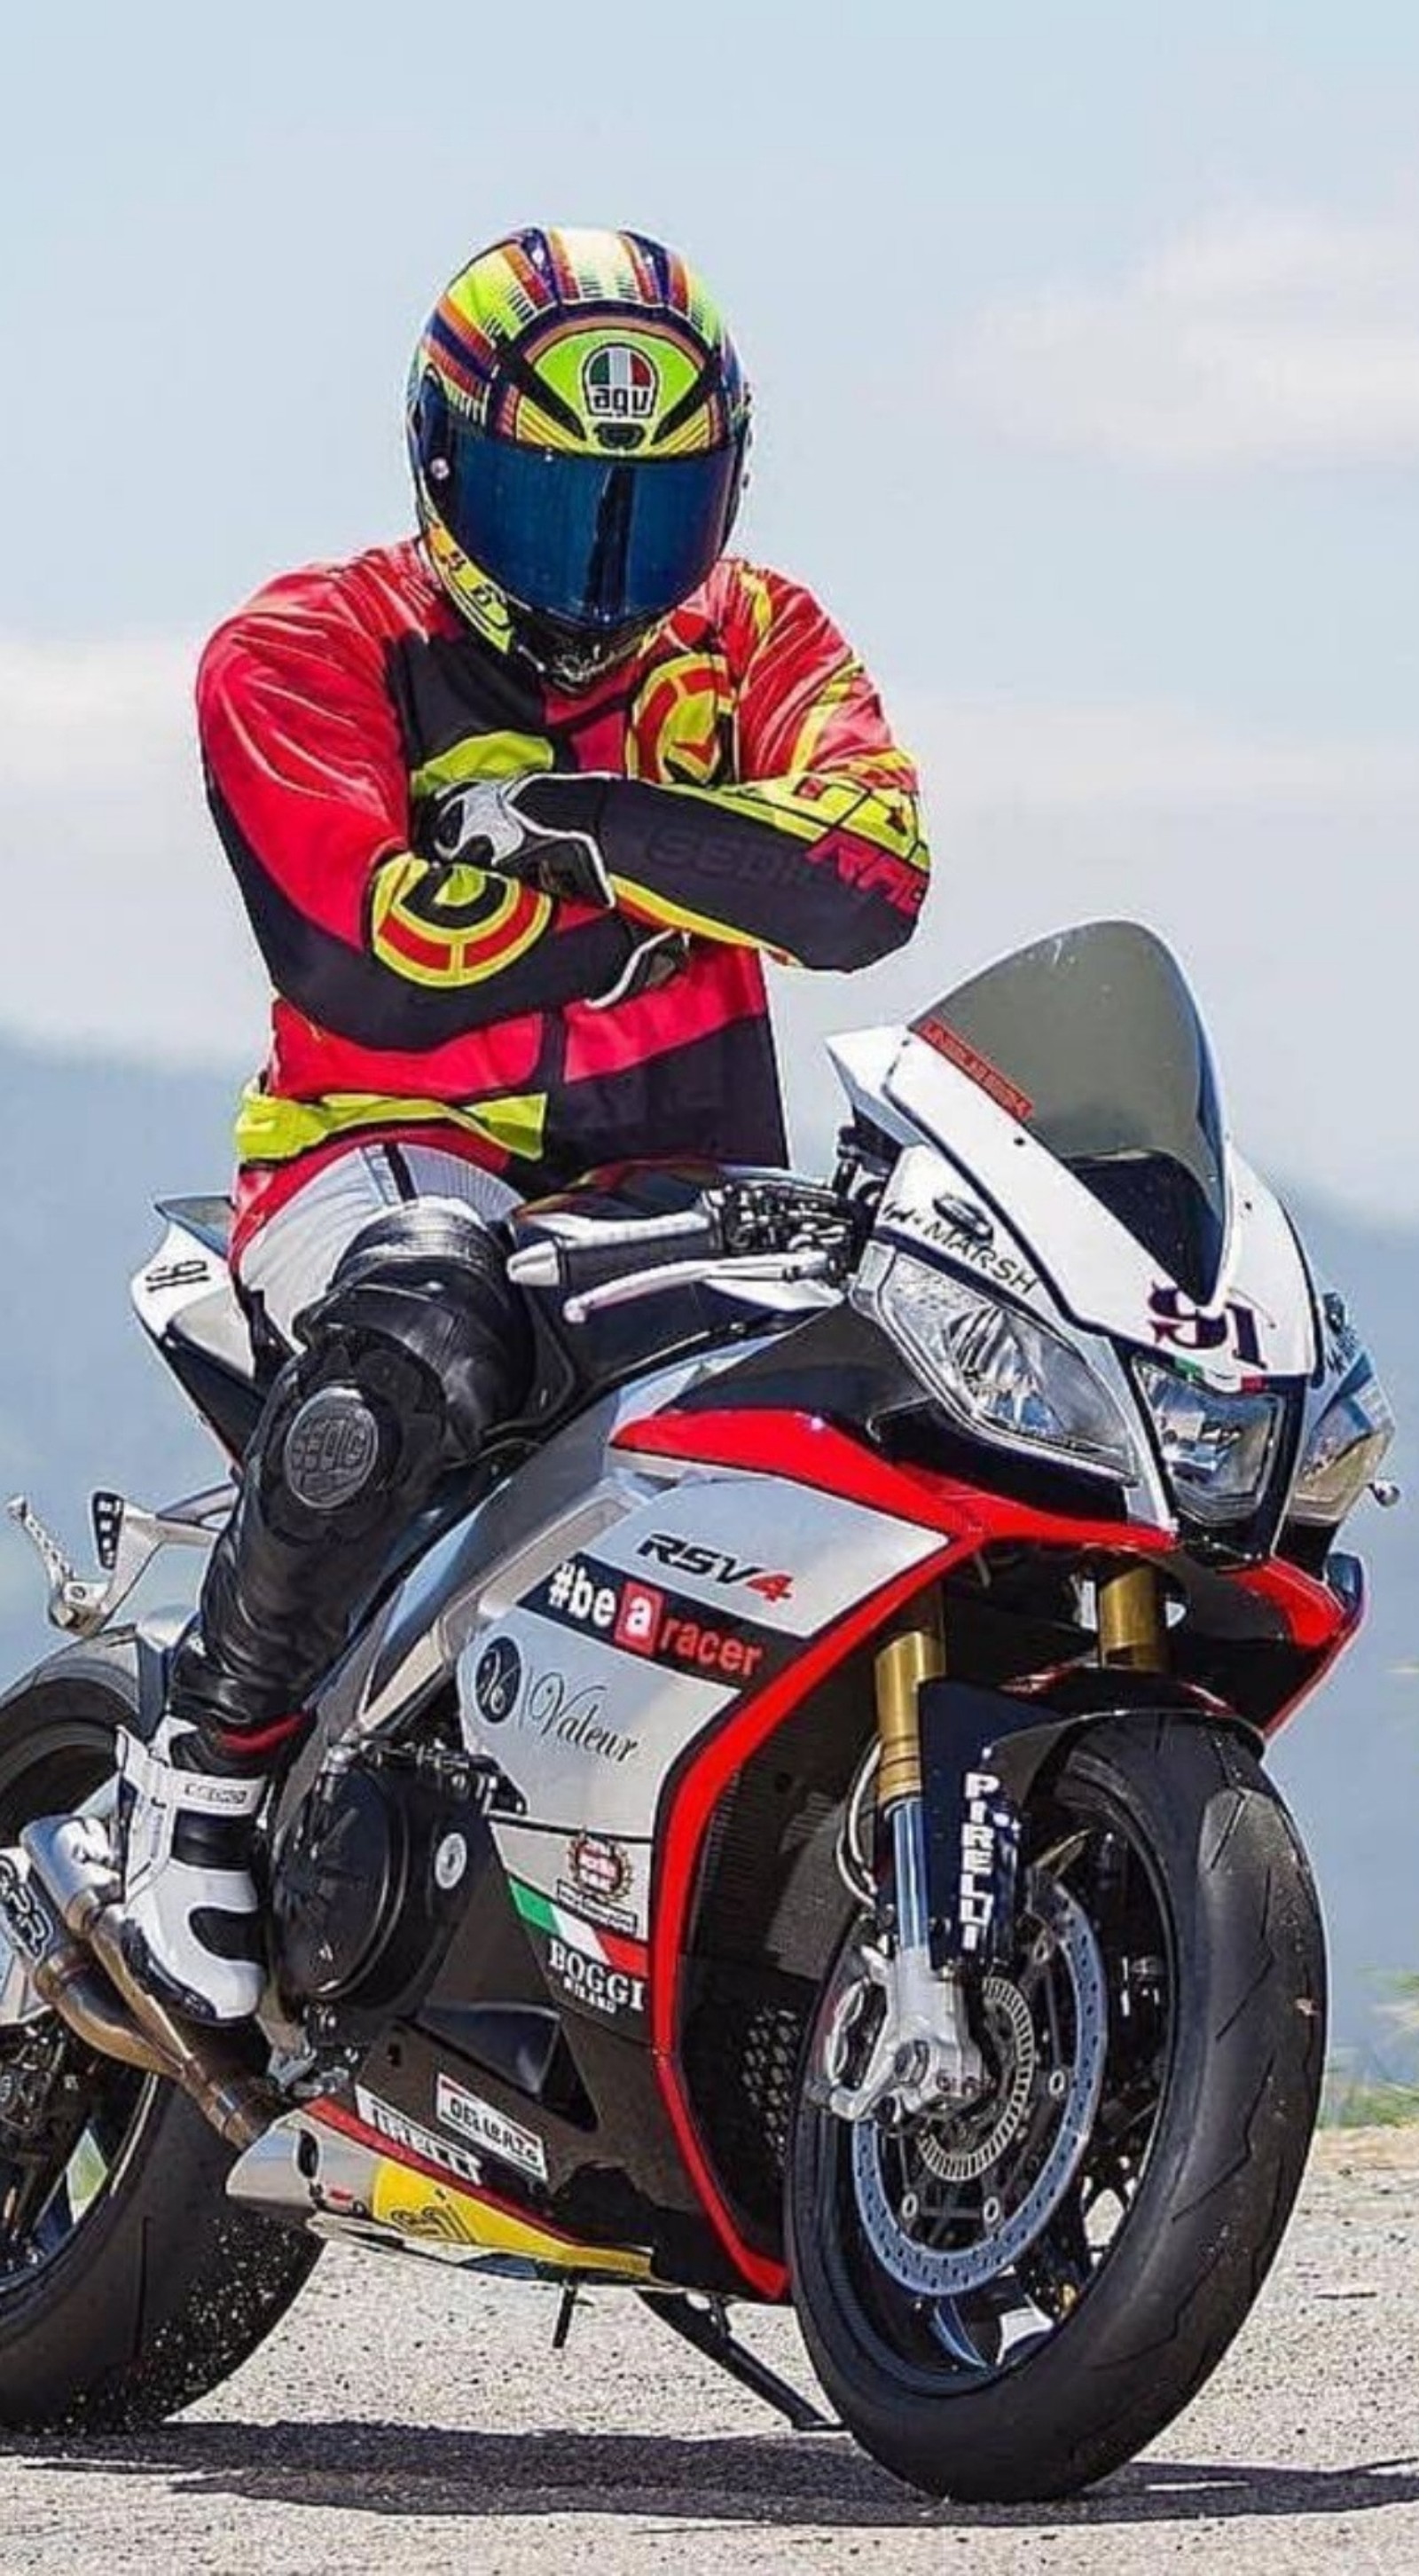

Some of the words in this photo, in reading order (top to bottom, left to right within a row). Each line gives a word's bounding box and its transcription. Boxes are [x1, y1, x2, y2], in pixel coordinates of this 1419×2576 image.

[593, 389, 649, 417] agv
[1148, 1281, 1266, 1370] 91
[637, 1533, 792, 1602] RSV4
[549, 1564, 616, 1627] #be
[625, 1597, 652, 1637] a
[660, 1617, 762, 1677] racer
[529, 1672, 639, 1763] Valeur
[960, 1772, 1000, 1951] PIRELLI
[550, 1939, 645, 2012] BOGGI
